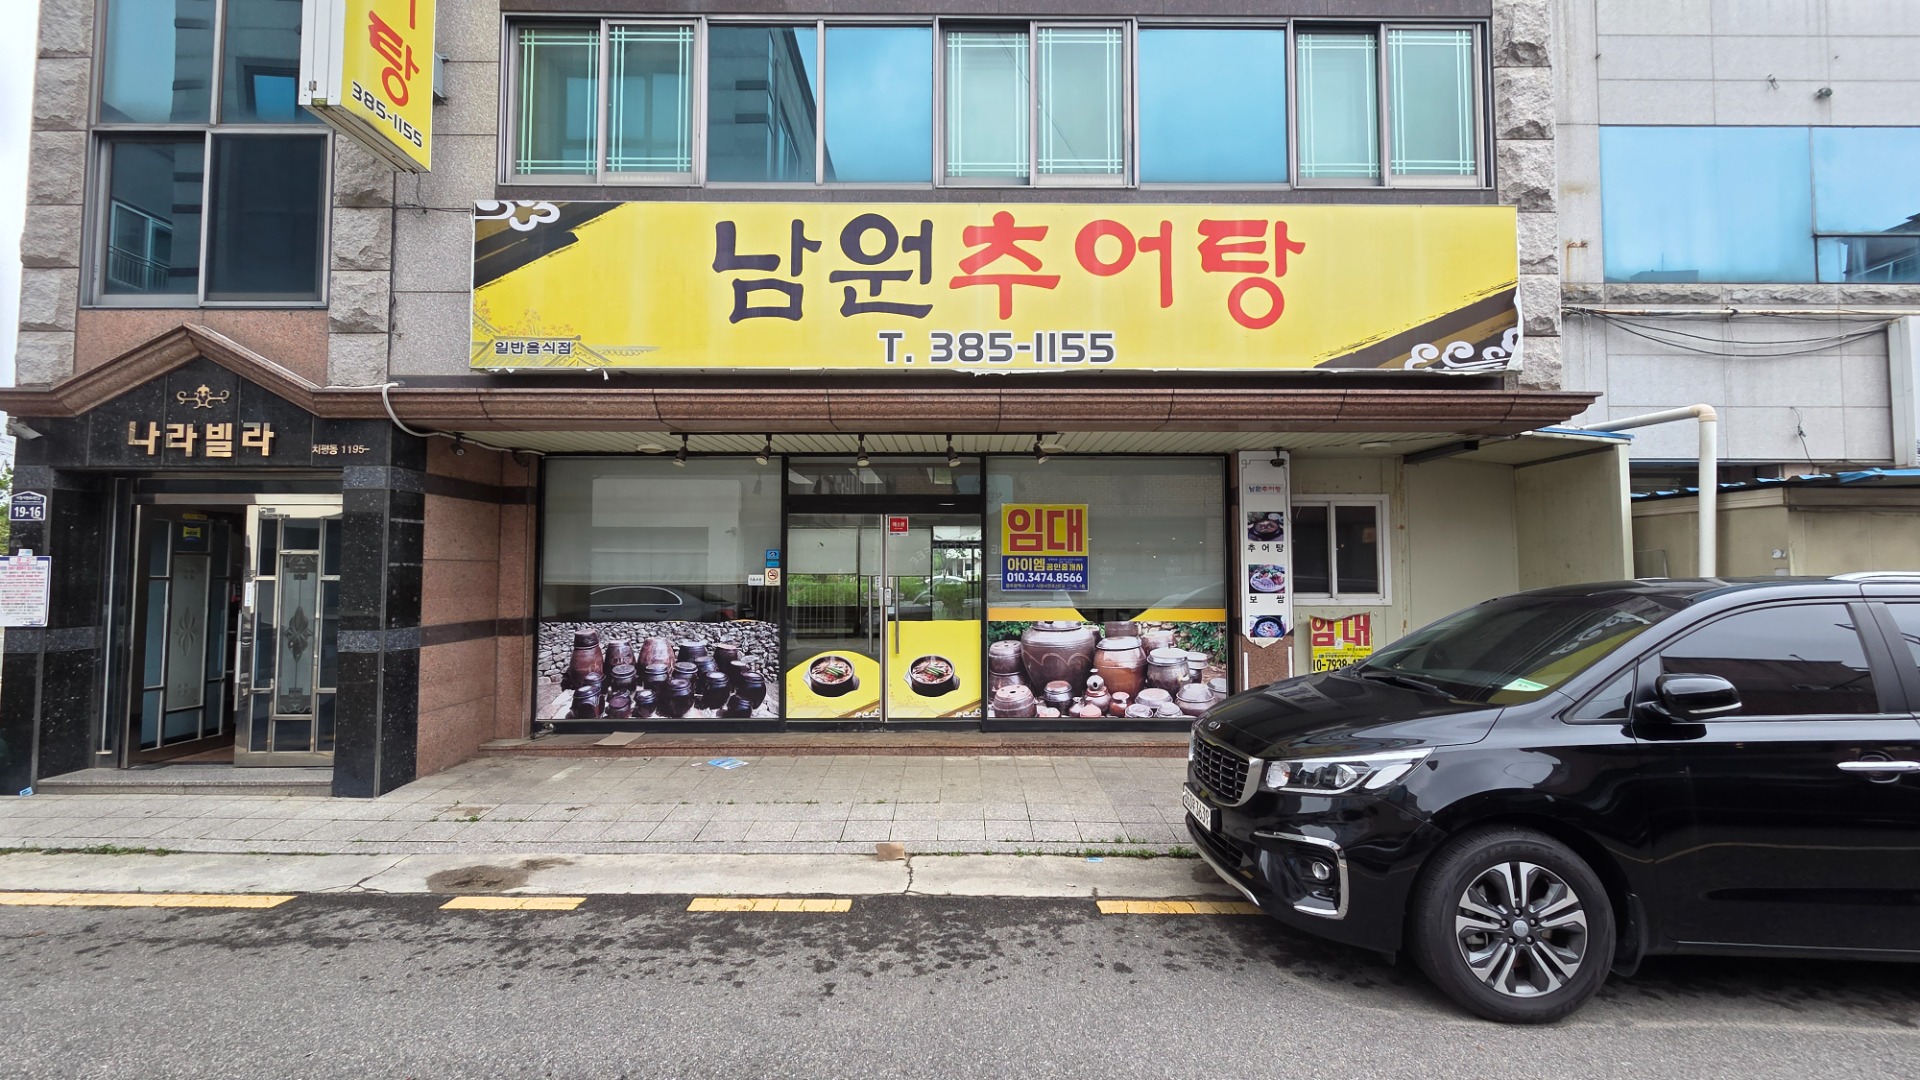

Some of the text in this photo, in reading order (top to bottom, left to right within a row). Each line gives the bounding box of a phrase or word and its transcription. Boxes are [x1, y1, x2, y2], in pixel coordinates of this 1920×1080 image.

[351, 80, 423, 149] 385-1155
[494, 341, 573, 355] 일반음식점
[876, 332, 1115, 363] T. 385-1155
[127, 420, 275, 458] 나라빌라
[13, 506, 42, 518] 19-16
[1007, 508, 1083, 553] 임대
[1006, 572, 1083, 583] 010.3474.8566
[1007, 557, 1046, 571] 아이엠
[1311, 613, 1371, 647] 임대
